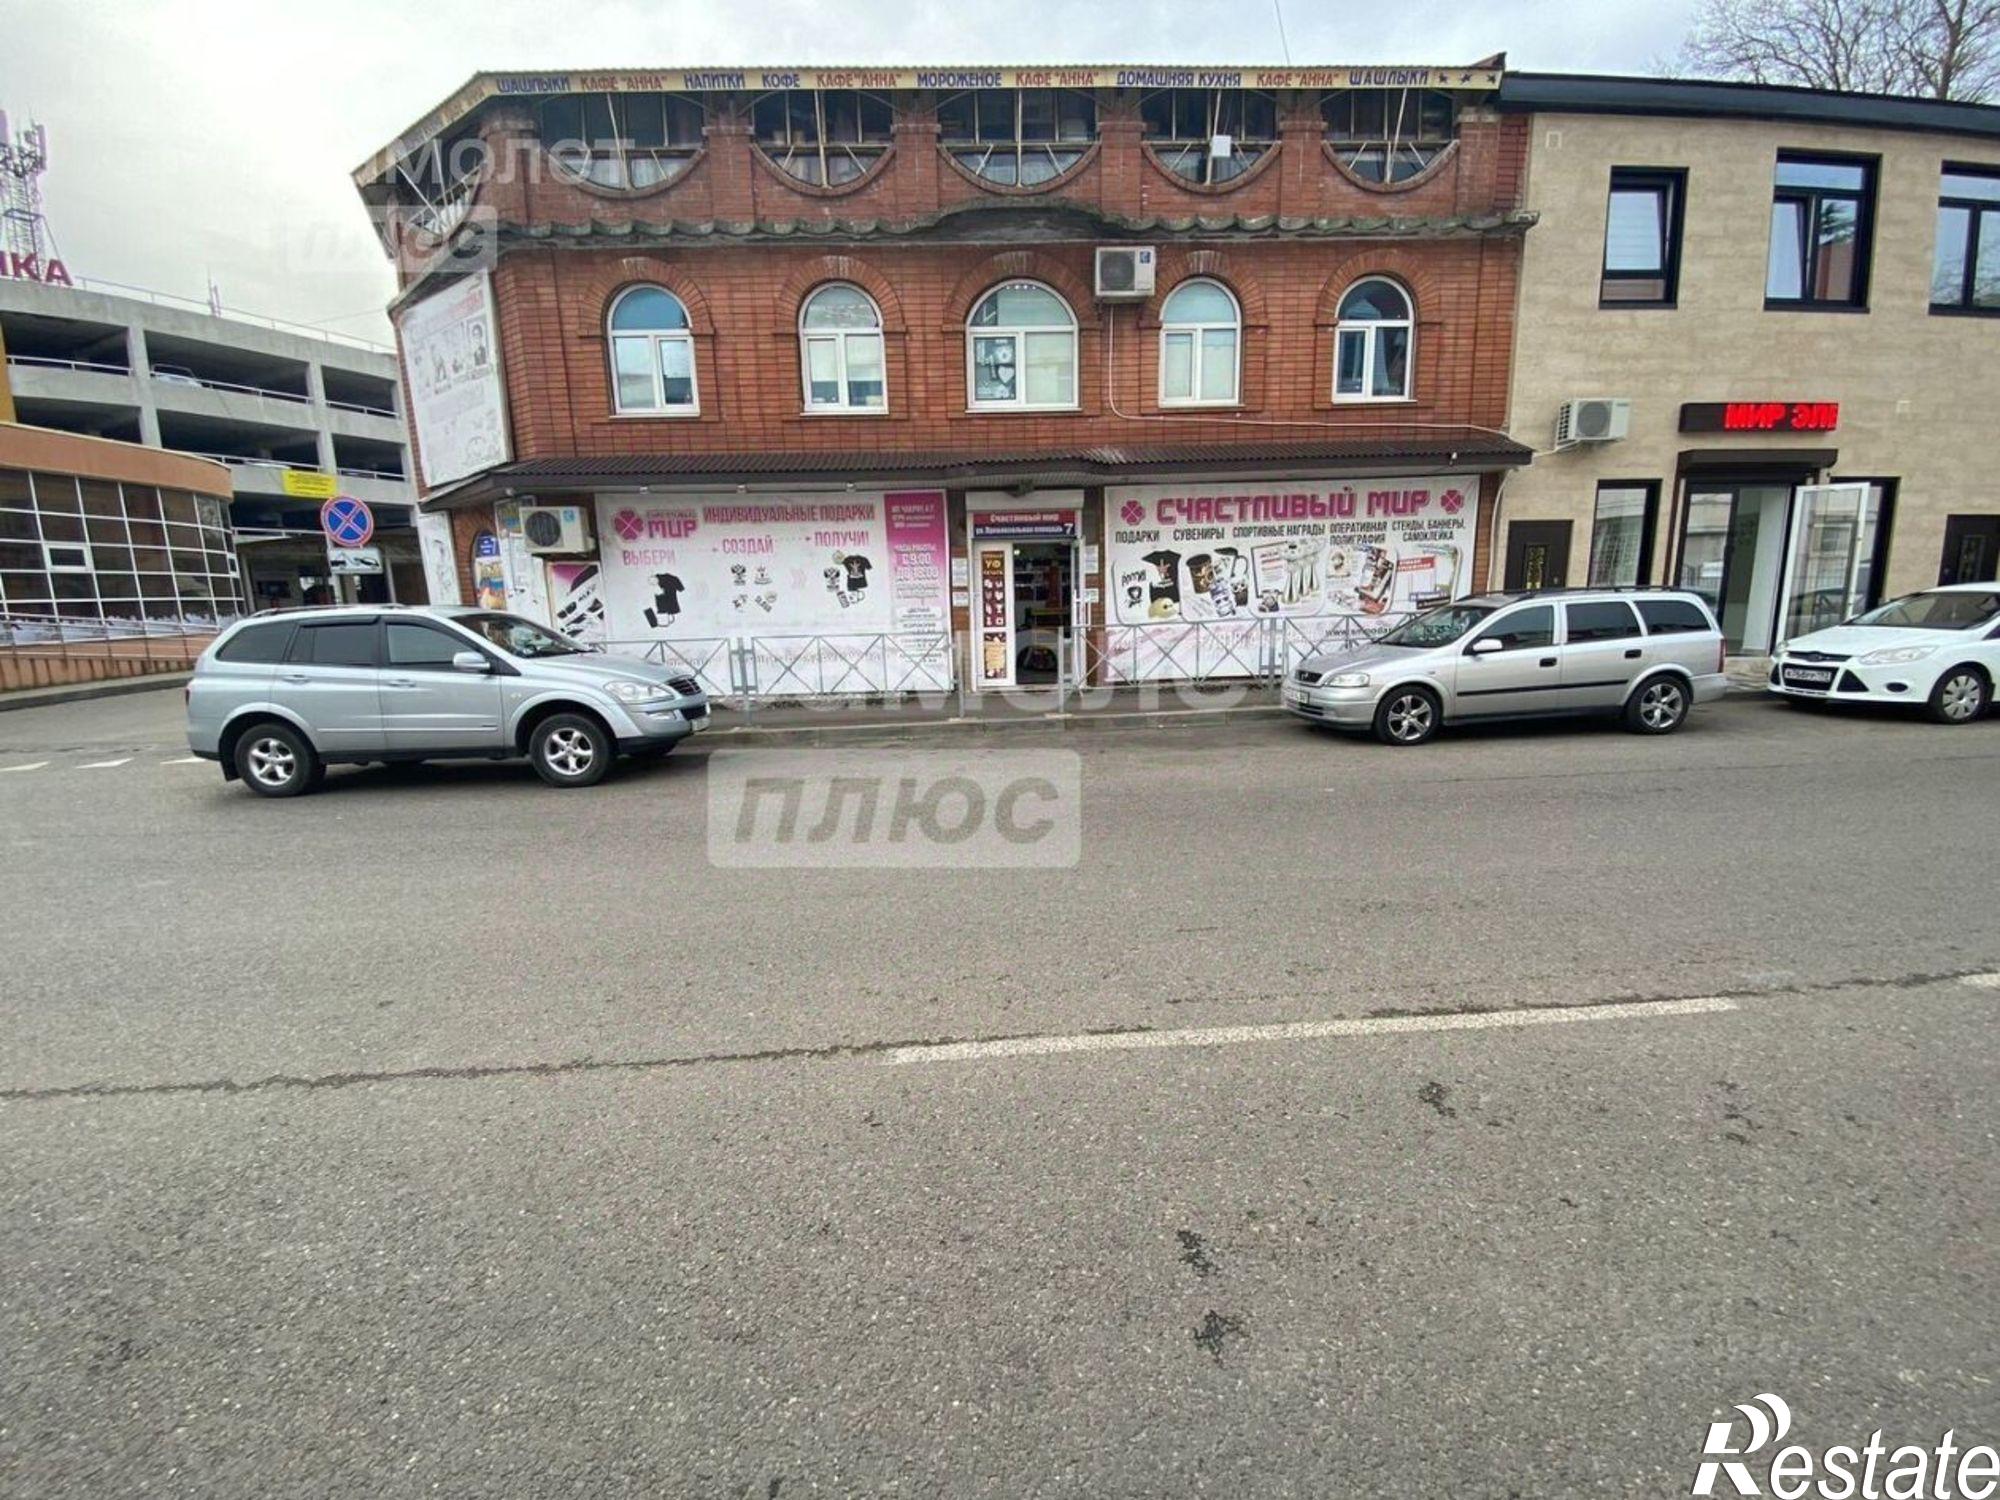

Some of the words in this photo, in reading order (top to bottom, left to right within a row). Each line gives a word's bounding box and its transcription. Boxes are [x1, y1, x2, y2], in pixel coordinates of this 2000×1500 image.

[496, 75, 571, 93] ШАШЛЫКИ
[580, 76, 619, 91] КАФЕ
[683, 73, 746, 90] НАПИТКИ
[762, 73, 801, 89] КОФЕ
[816, 73, 853, 88] КАФЕ
[917, 72, 1002, 88] МОРОЖЕНОЕ
[1015, 72, 1051, 87] КАФЕ
[1117, 71, 1194, 87] ДОМАШНЯЯ
[1198, 72, 1242, 87] КУХНЯ
[1256, 73, 1292, 88] КАФЕ
[1349, 70, 1429, 86] ШАШЛЫКИ
[1724, 403, 1786, 431] МИР
[703, 505, 819, 524] ИНДИВИДУАЛЬНЫЕ
[820, 503, 876, 522] ПОДАРКИ
[1156, 487, 1358, 525] СЧАСТЛИВЫЙ
[1366, 490, 1431, 518] МИР
[1063, 523, 1074, 535] 7
[1173, 527, 1225, 541] СУВЕНИРЫ
[1233, 525, 1284, 538] СПОРТИВНЫЕ
[1286, 523, 1325, 536] НАГРАДЫ
[1330, 521, 1388, 534] ОПЕРАТИВНАЯ
[1115, 530, 1160, 544] ПОДАРКИ
[1329, 533, 1386, 546] ПОЛИГРАФИЯ
[1403, 529, 1454, 542] САМОКЛЕЙКА
[723, 535, 774, 555] СОЗДАЙ
[623, 549, 676, 566] ВЫБЕРИ
